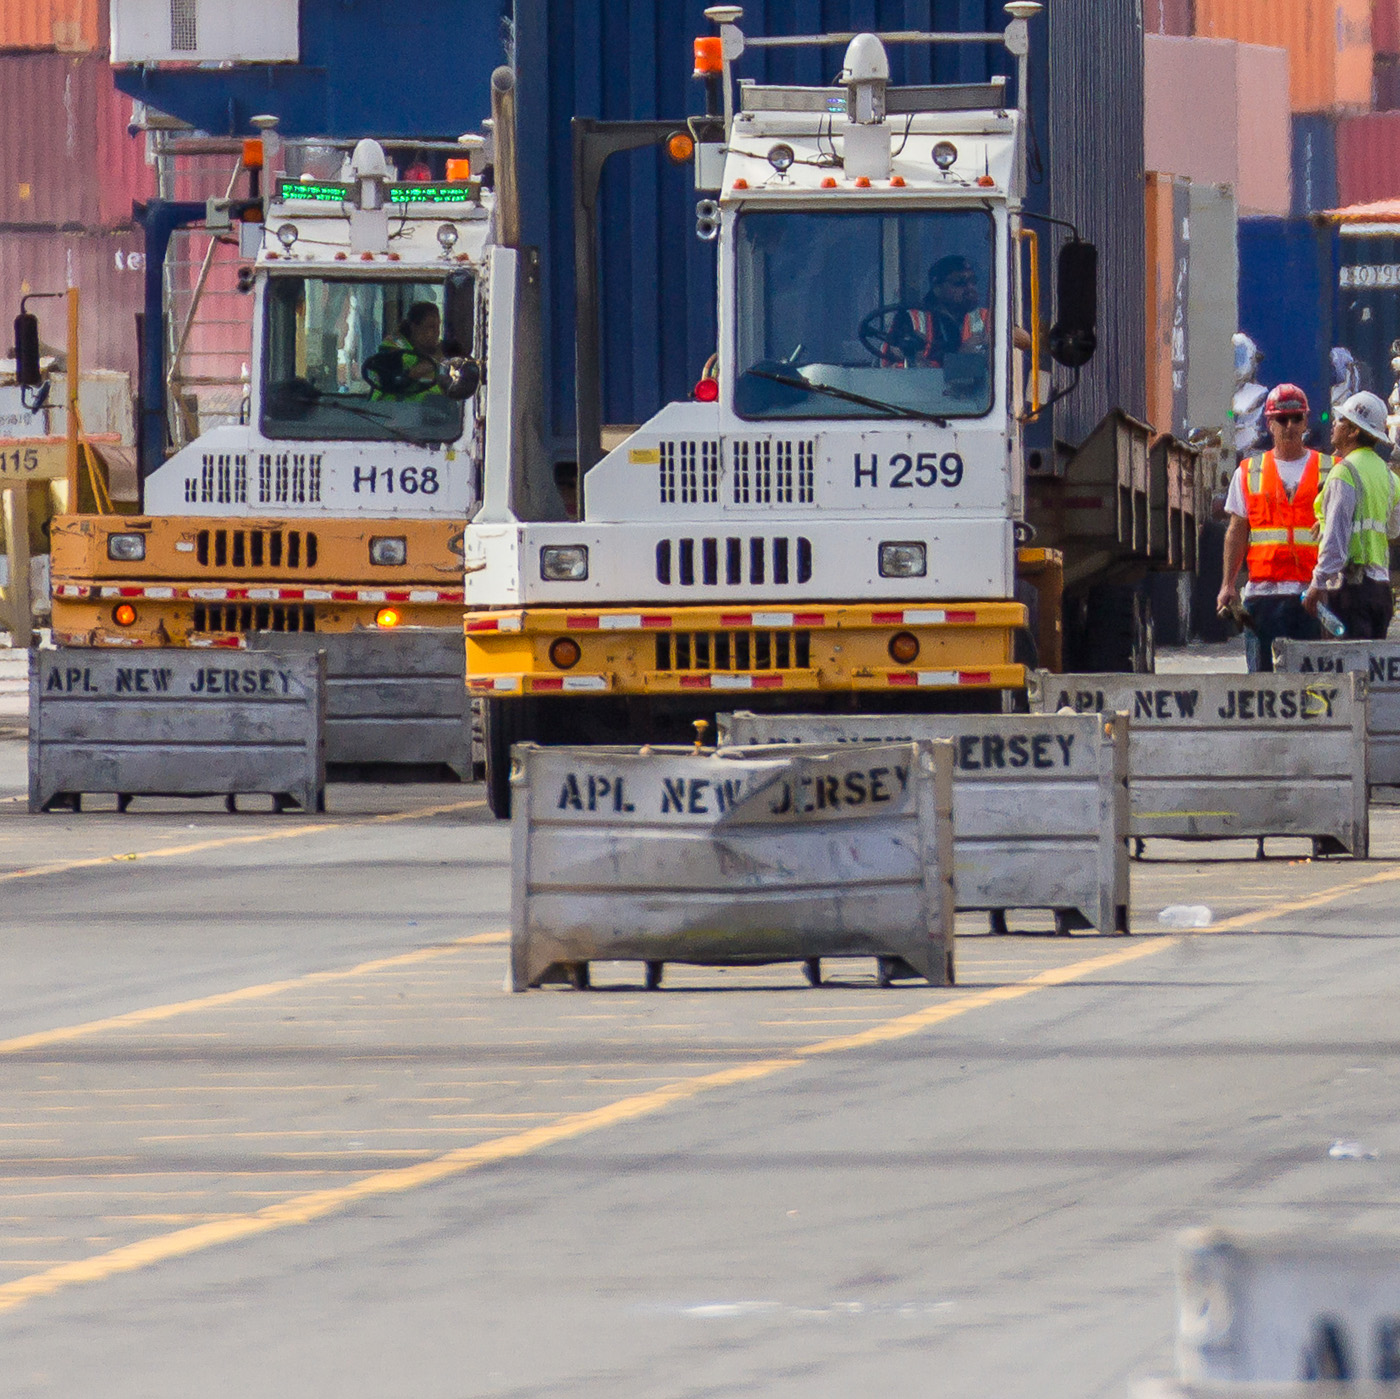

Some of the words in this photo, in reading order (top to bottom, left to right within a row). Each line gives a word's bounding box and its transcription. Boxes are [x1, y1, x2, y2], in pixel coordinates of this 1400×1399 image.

[353, 465, 440, 494] H168
[46, 666, 98, 692] APL
[115, 667, 172, 693] NEW
[189, 667, 292, 693] JERSEY
[1134, 689, 1199, 719] NEW
[1218, 689, 1338, 719] JERSEY
[953, 734, 1076, 771] ERSEY
[557, 772, 635, 813] APL
[660, 777, 742, 814] NEW
[771, 765, 913, 815] JERSEY
